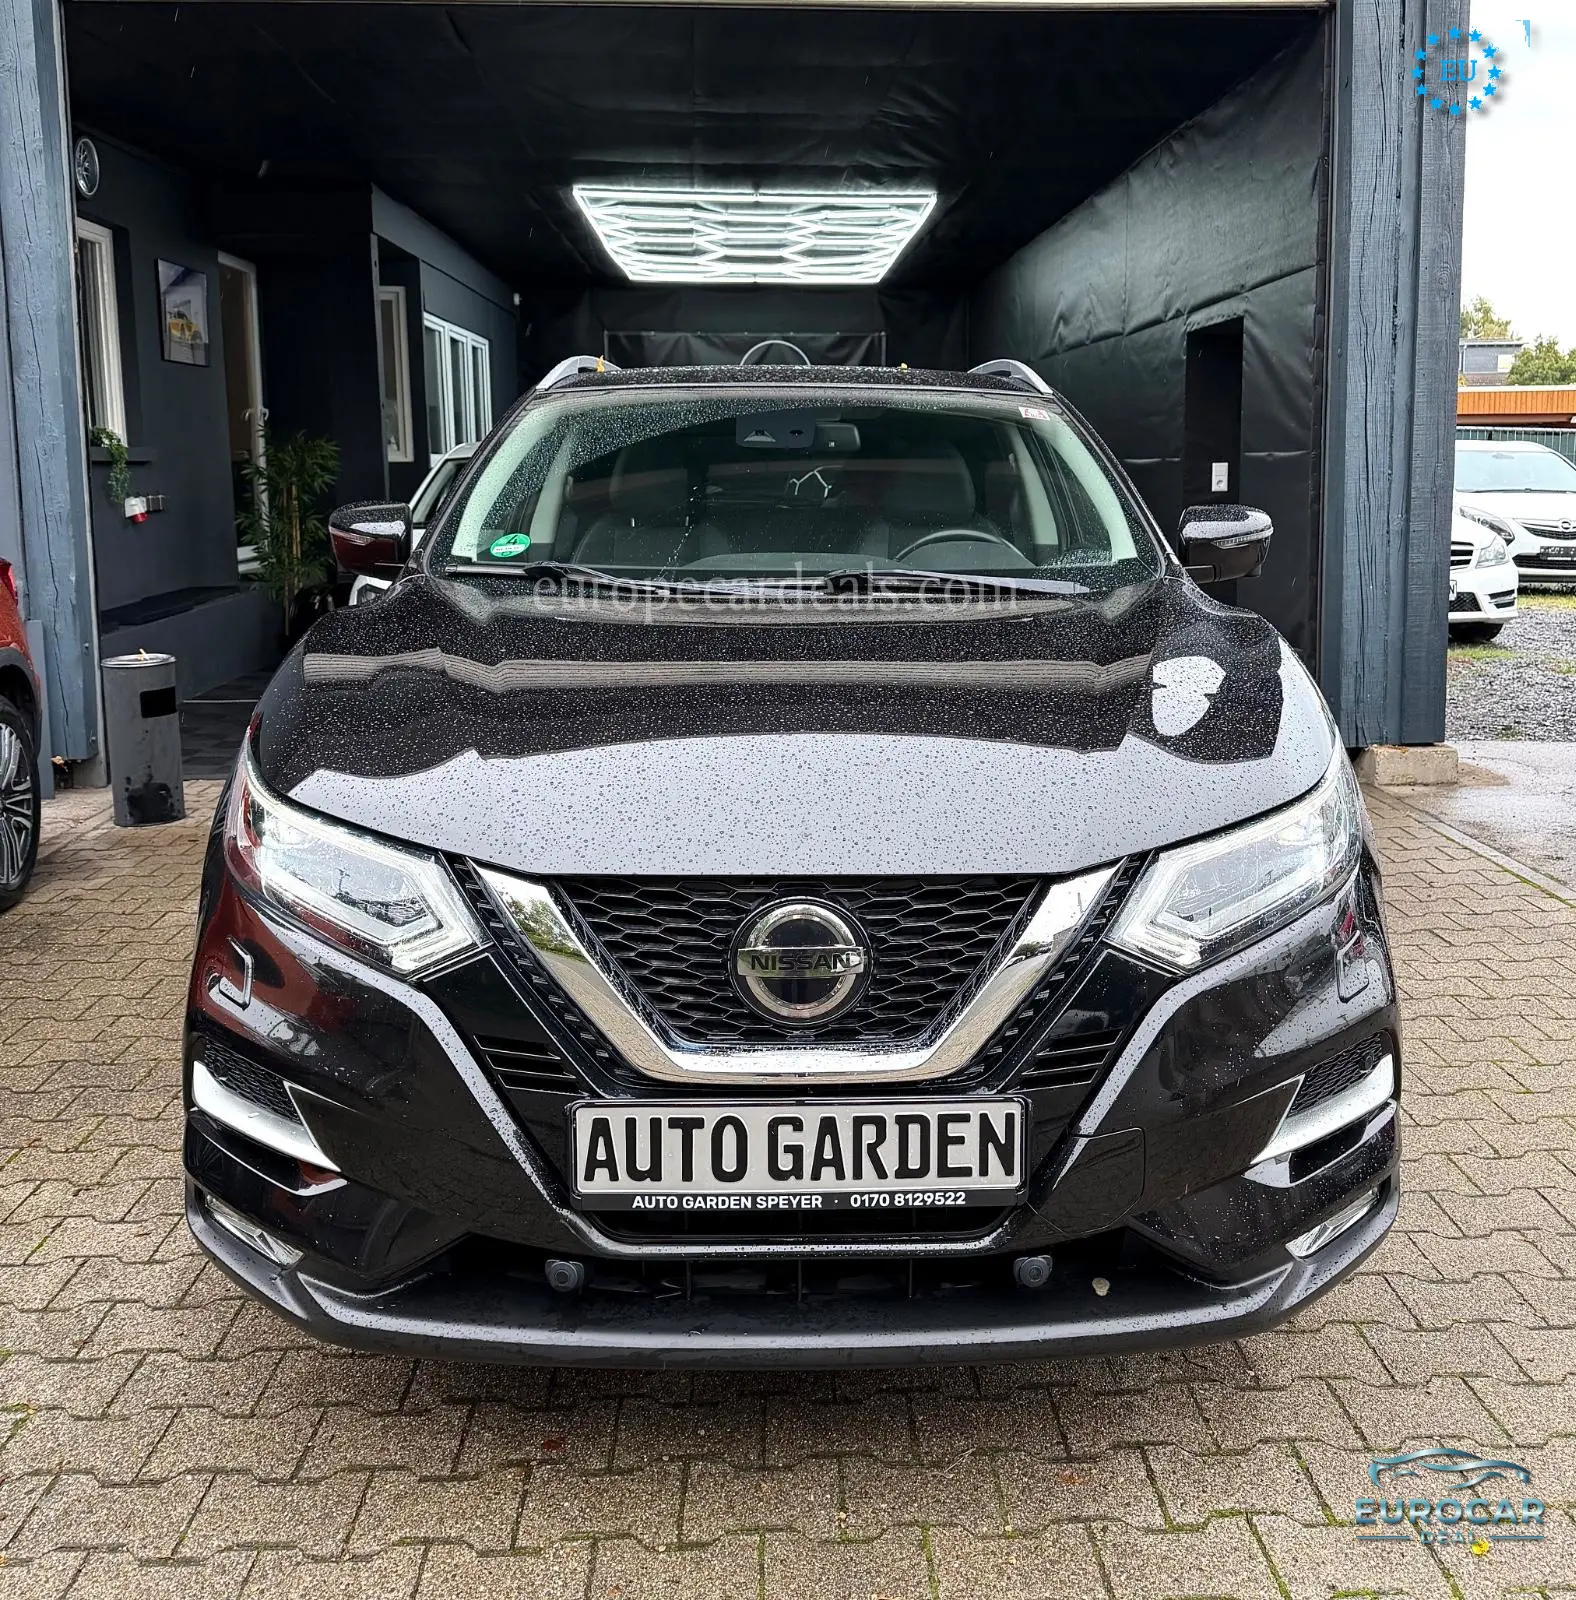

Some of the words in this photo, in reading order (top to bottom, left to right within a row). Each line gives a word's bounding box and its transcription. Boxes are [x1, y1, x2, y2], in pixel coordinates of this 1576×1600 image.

[751, 953, 850, 971] NISSAN
[583, 1115, 748, 1183] AUTO
[767, 1112, 1015, 1182] GARDEN
[632, 1195, 679, 1209] AUTO
[682, 1195, 752, 1209] GARDEN
[756, 1195, 822, 1209] SPEYER
[850, 1193, 890, 1207] 0170
[894, 1191, 966, 1206] 8129522
